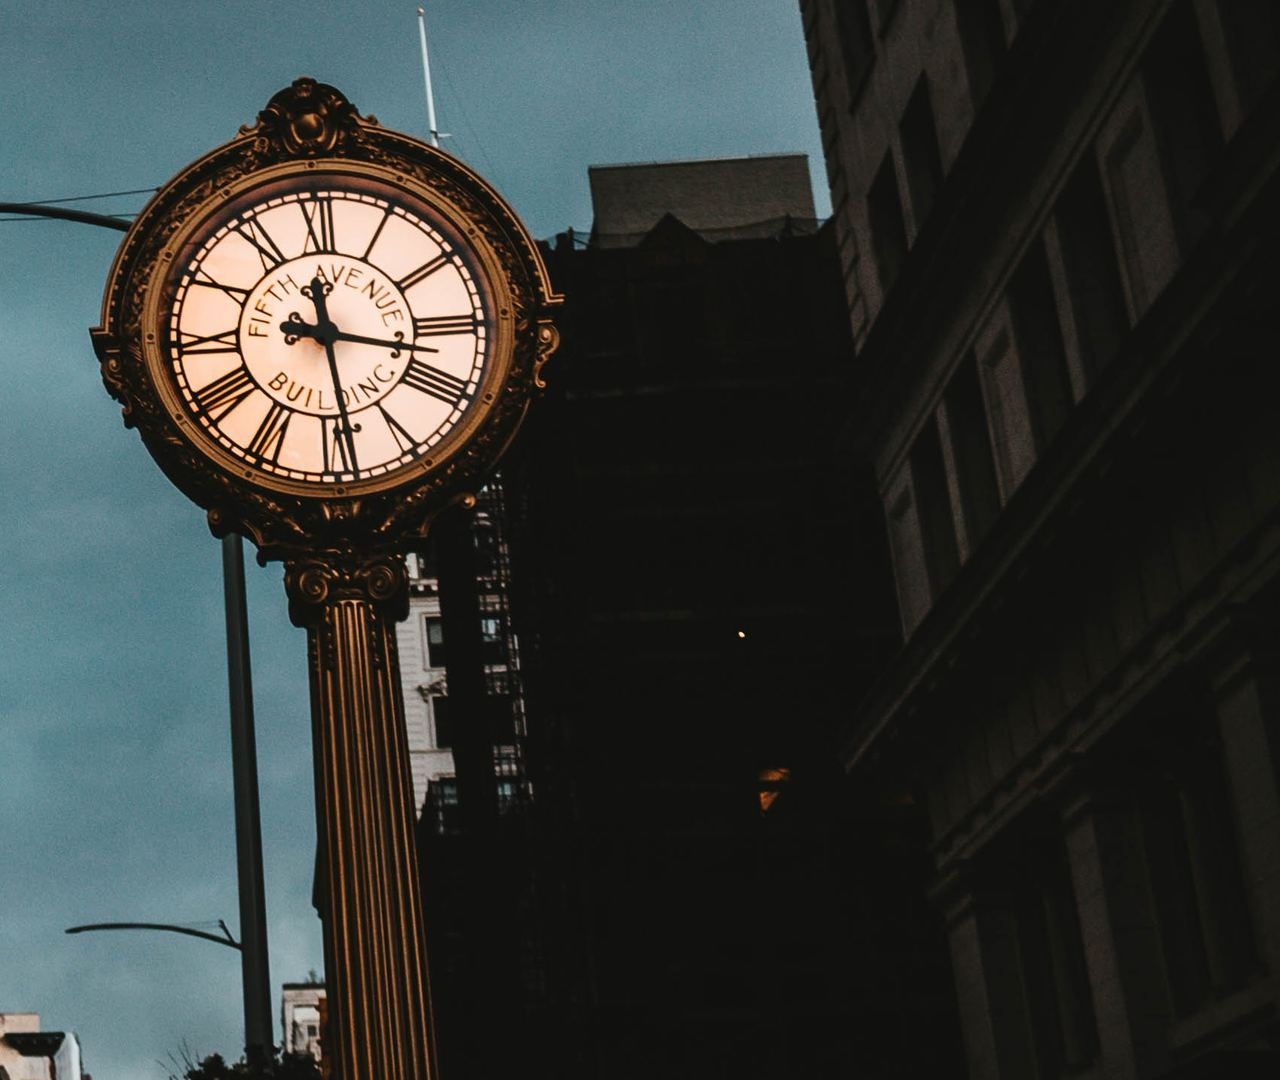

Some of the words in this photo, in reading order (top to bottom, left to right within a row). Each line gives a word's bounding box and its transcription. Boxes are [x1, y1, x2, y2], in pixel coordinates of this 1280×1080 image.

[248, 273, 299, 338] FIFTH
[315, 263, 405, 328] AVENUE
[267, 363, 396, 410] BUILDING
